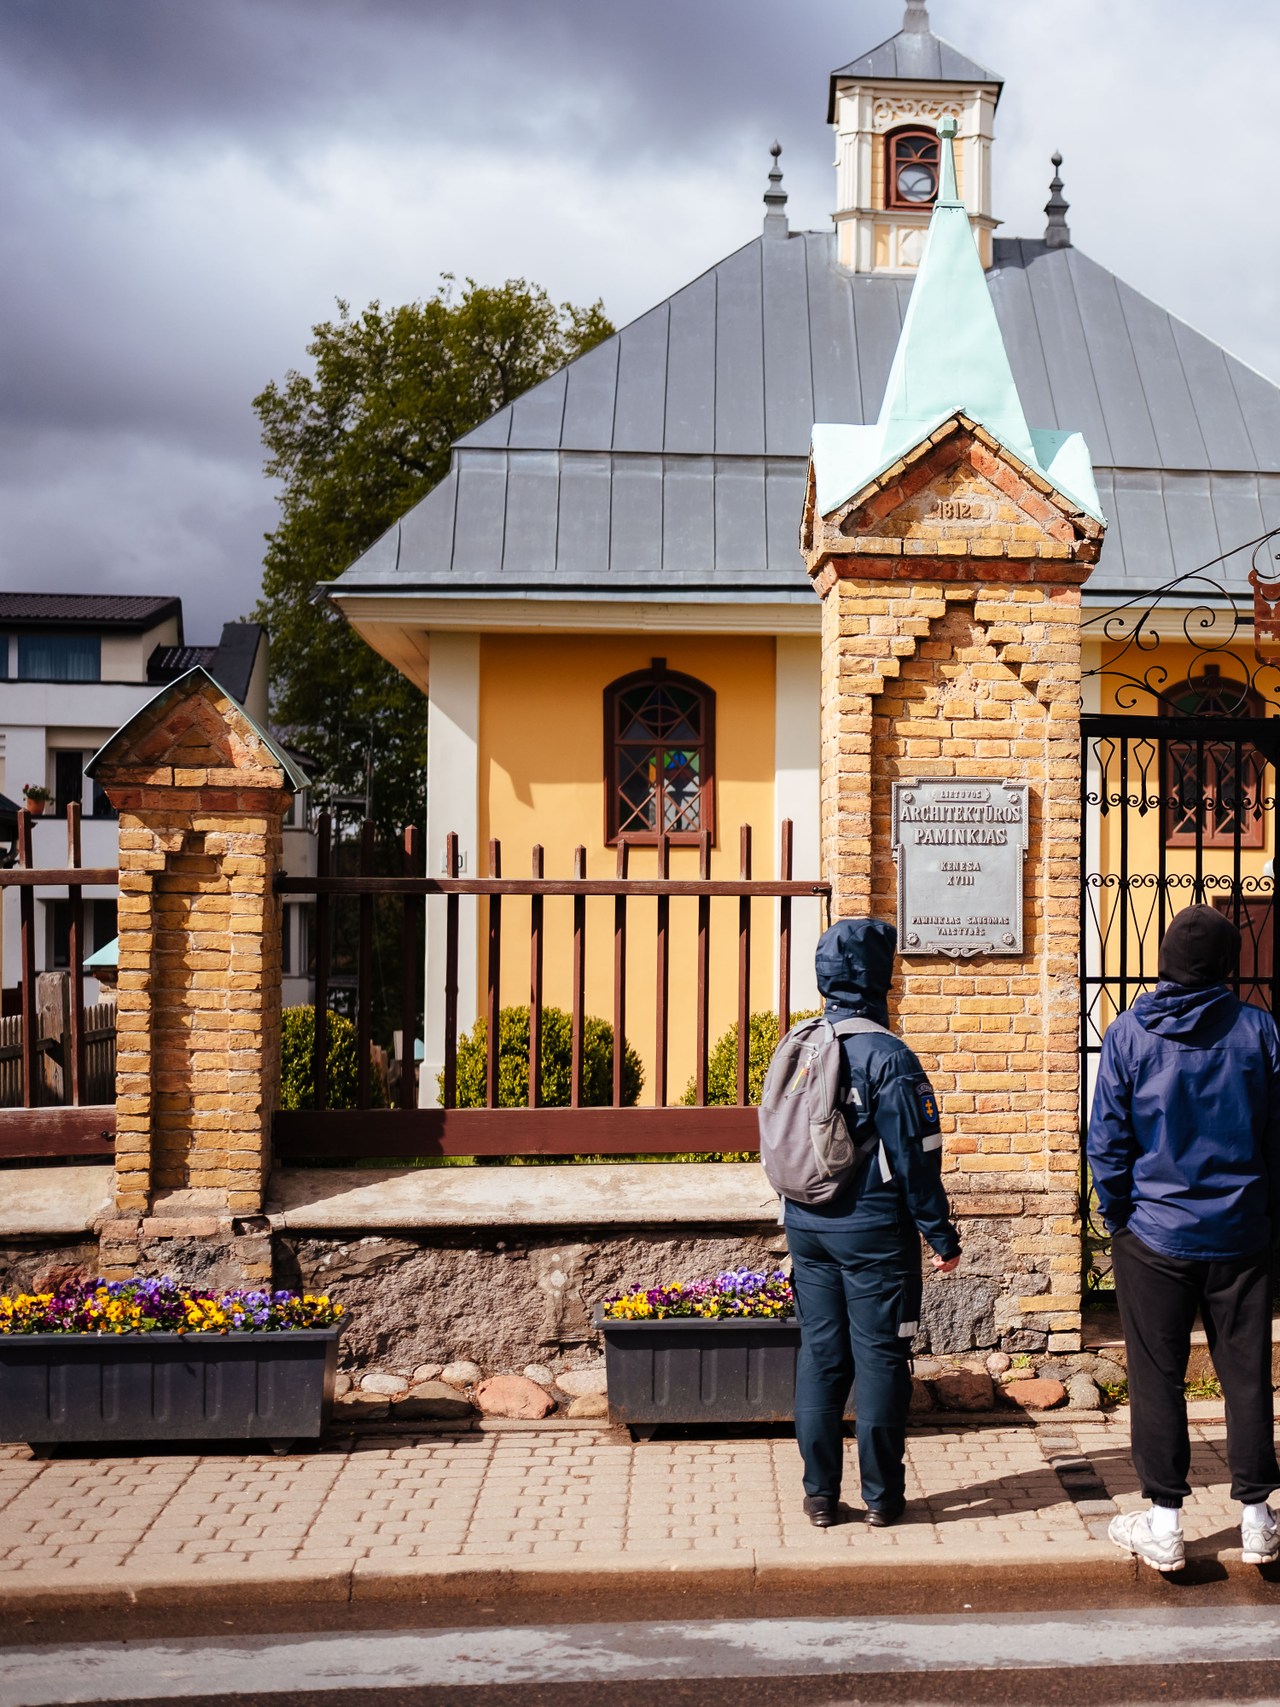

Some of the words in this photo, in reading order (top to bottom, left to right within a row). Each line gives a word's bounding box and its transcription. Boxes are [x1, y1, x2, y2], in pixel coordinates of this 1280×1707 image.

[939, 501, 971, 520] 1812
[941, 790, 982, 799] LIETUVOS
[901, 804, 1021, 823] ARCHITEKTŪROS
[915, 828, 1008, 846] PAMINKLAS
[940, 861, 981, 872] KENESA
[947, 876, 975, 886] XVIII
[911, 916, 961, 925] PAMINKLAS
[967, 916, 1009, 925] SAUGOMAS
[937, 926, 986, 936] VALSTYBĖS
